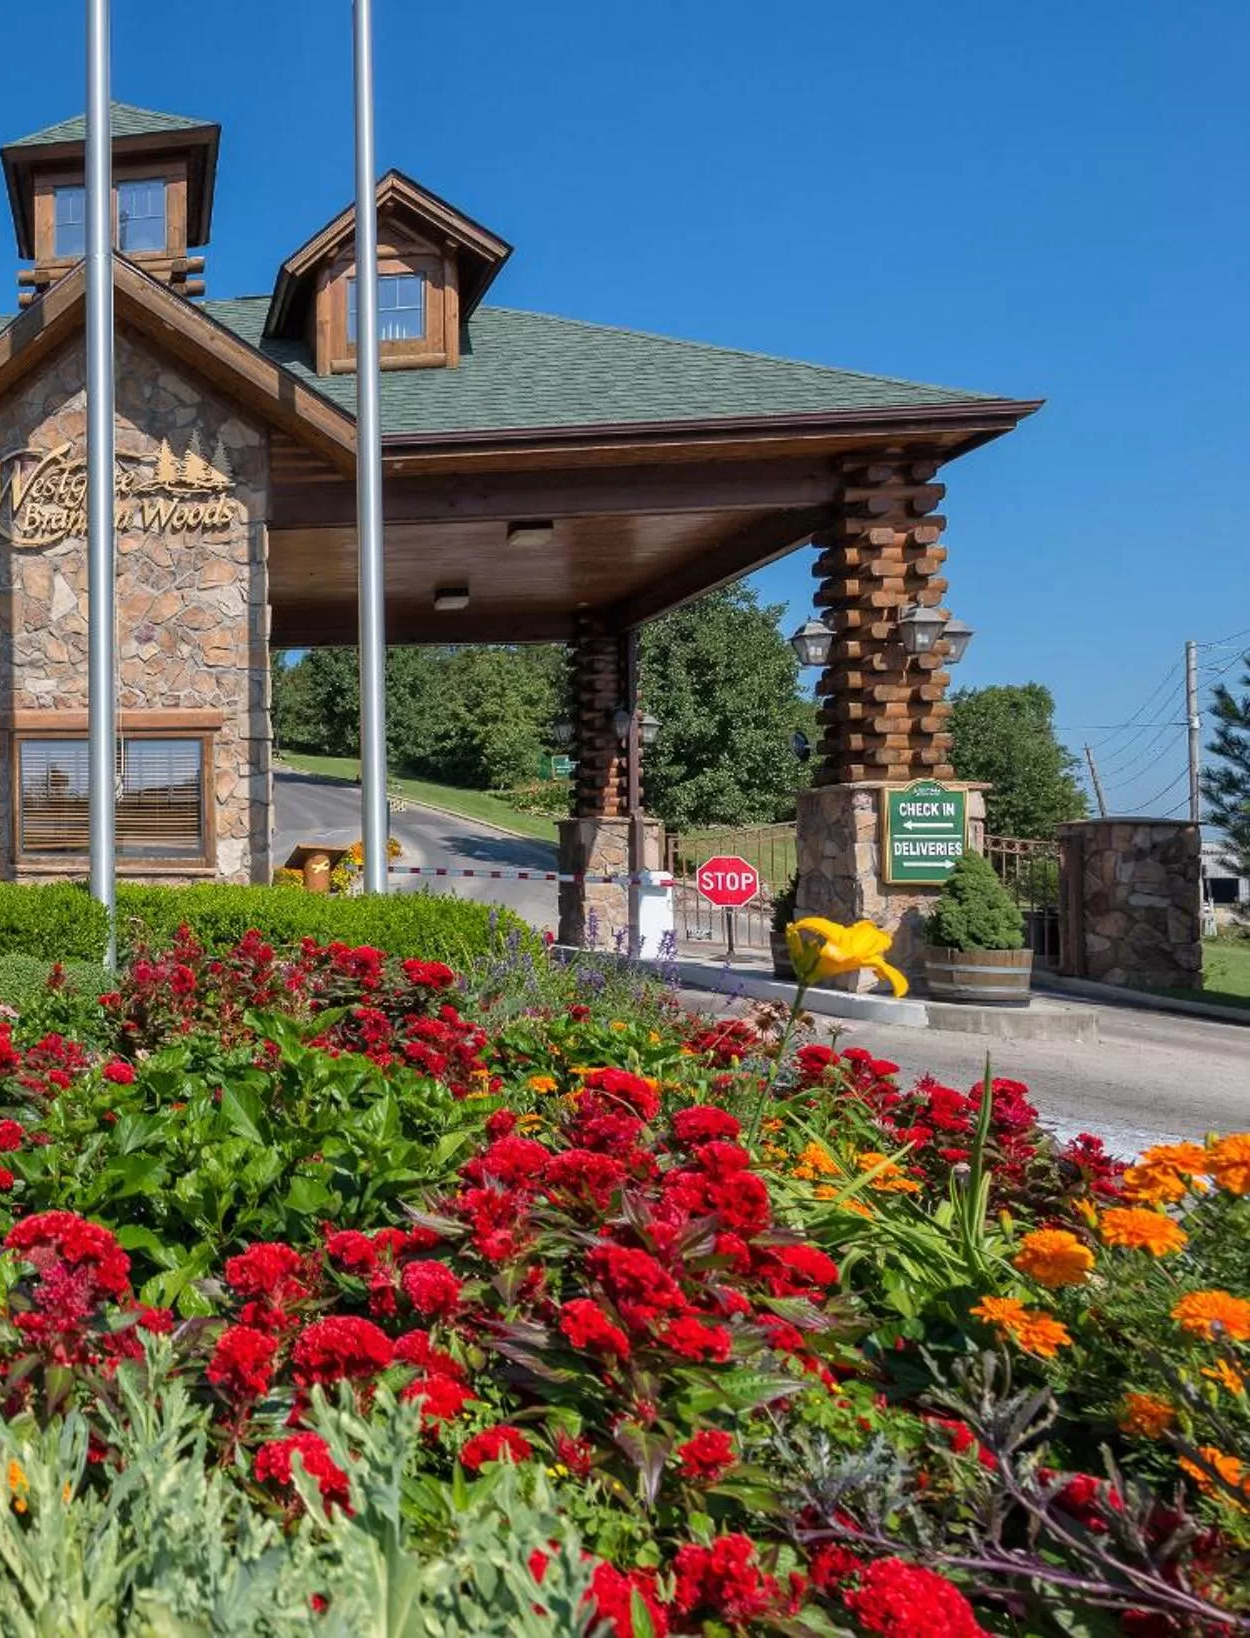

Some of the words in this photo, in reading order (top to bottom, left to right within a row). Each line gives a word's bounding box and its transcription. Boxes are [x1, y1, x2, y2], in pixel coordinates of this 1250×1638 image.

[24, 502, 134, 531] Brann
[141, 493, 234, 531] Woods
[899, 802, 939, 817] CHECK
[942, 802, 956, 817] IN
[894, 842, 963, 856] DELIVERIES
[701, 872, 754, 891] STOP
